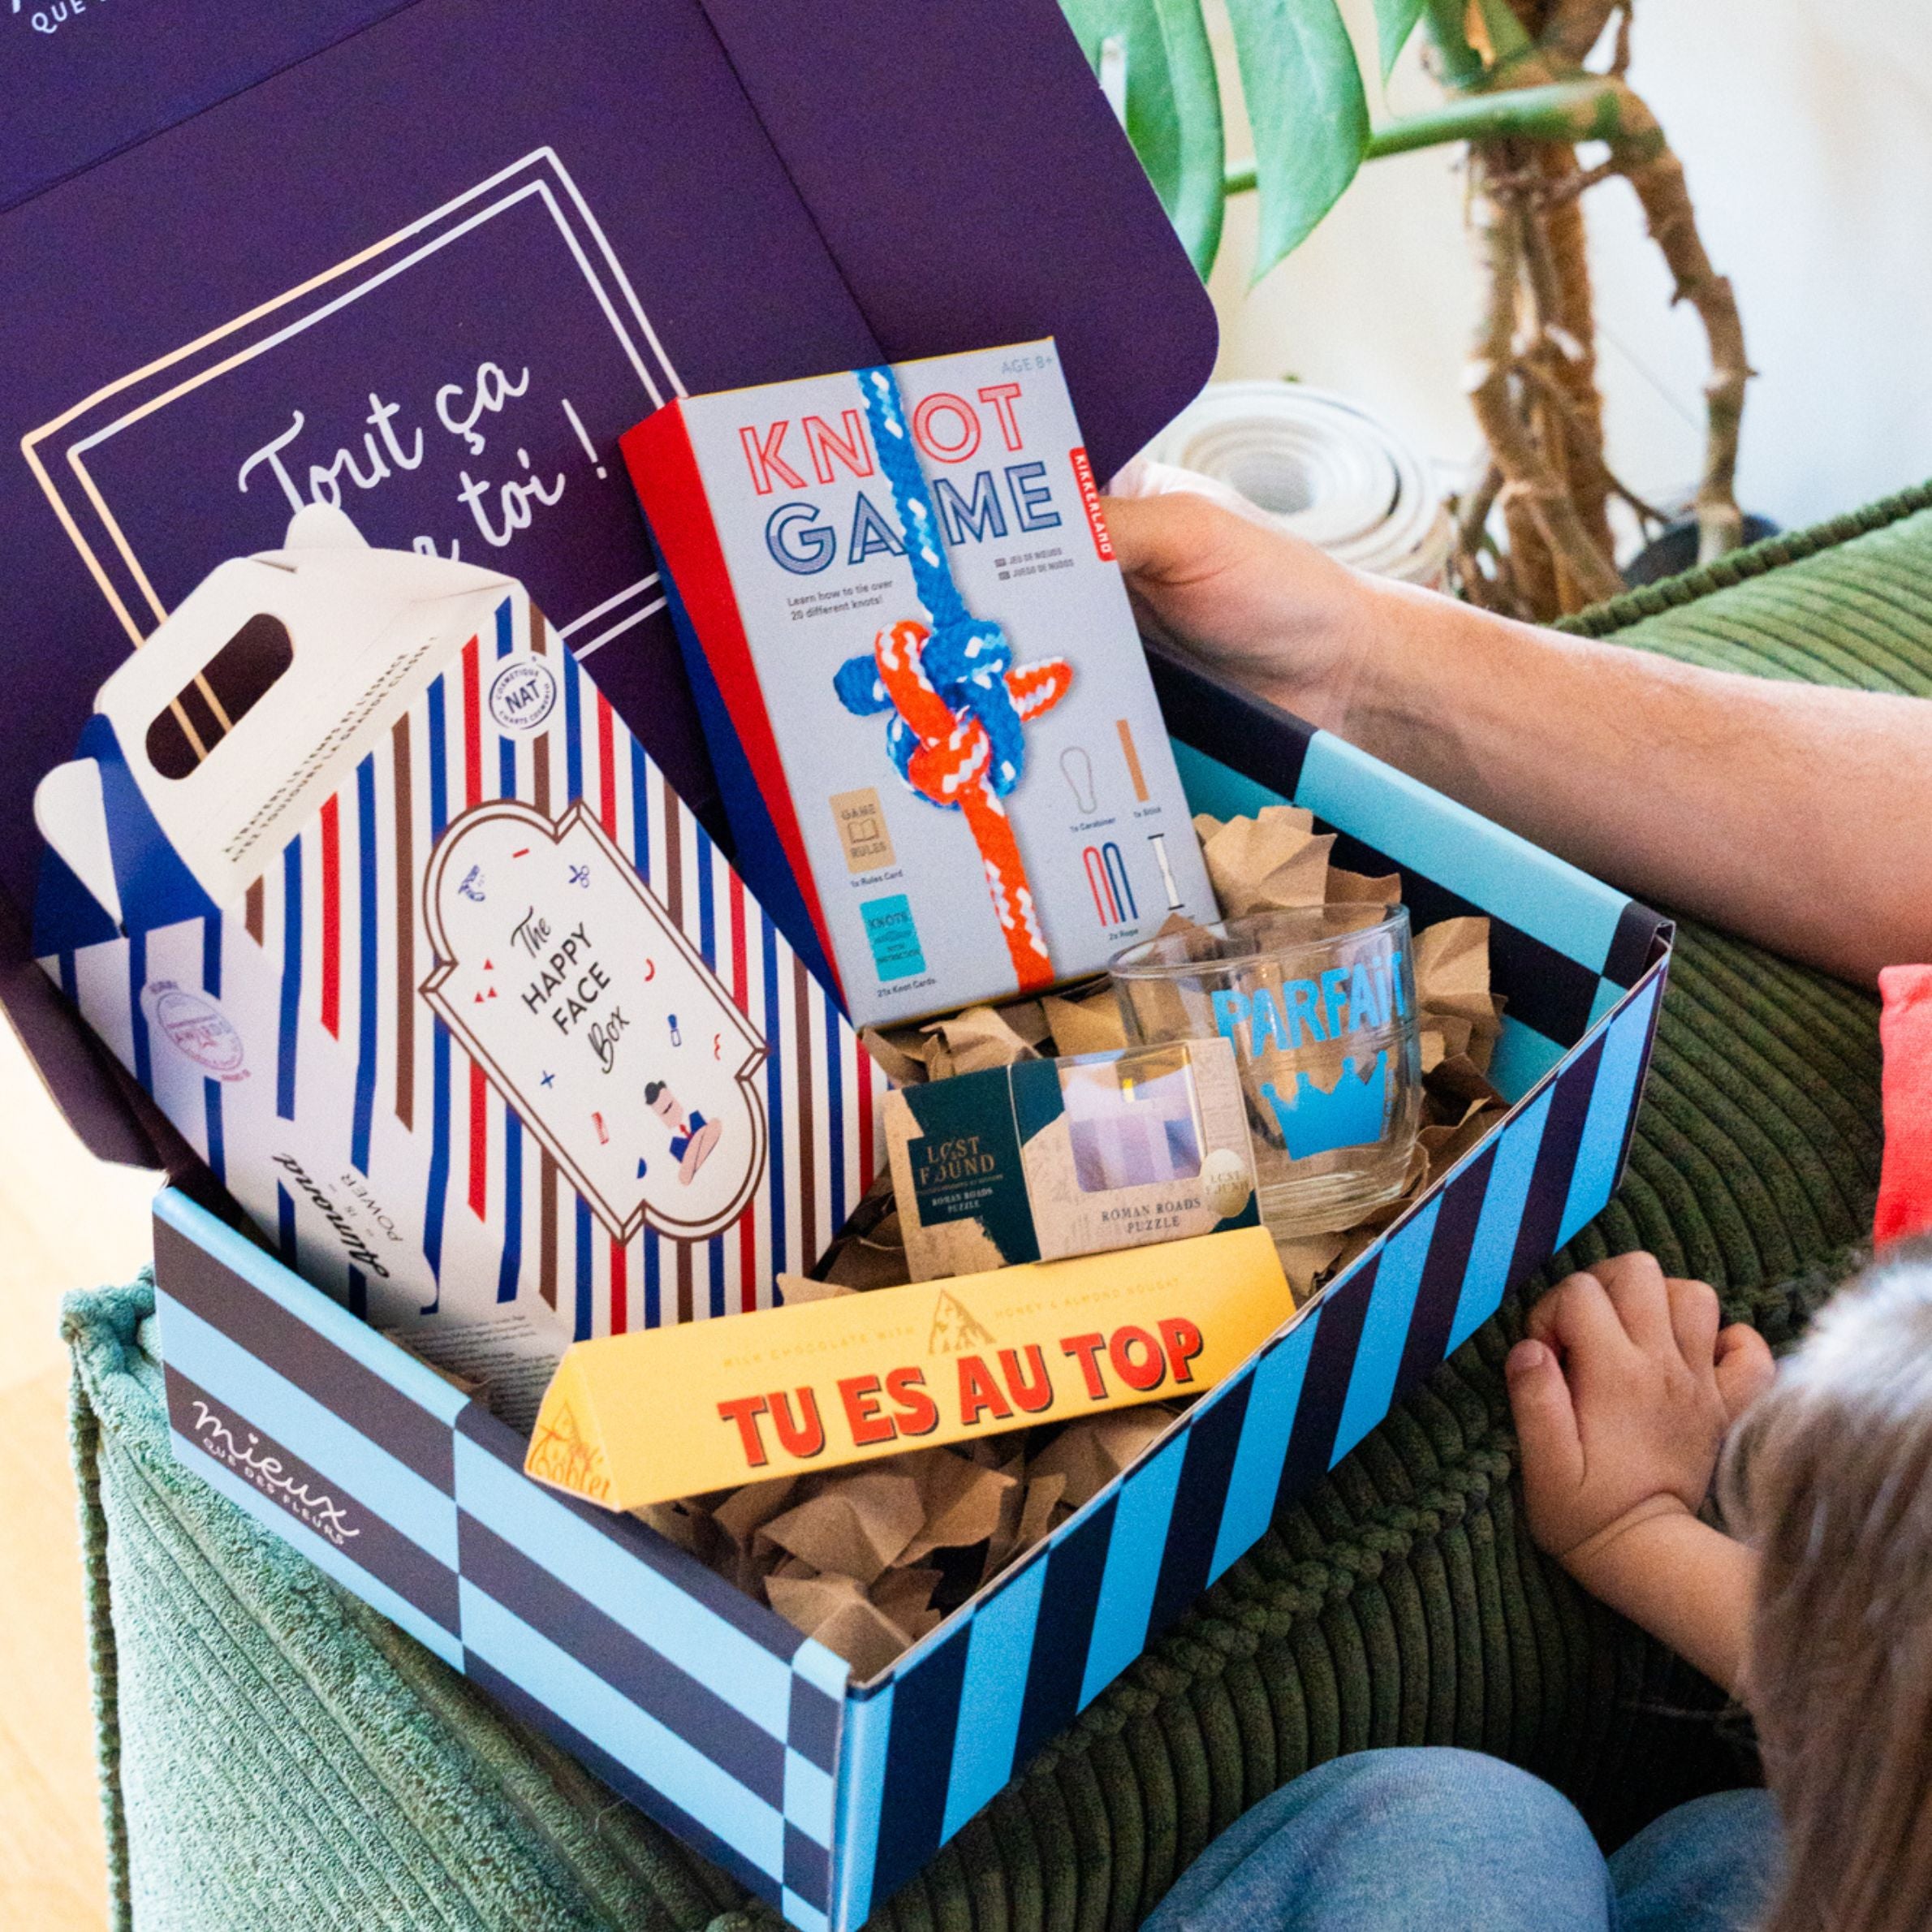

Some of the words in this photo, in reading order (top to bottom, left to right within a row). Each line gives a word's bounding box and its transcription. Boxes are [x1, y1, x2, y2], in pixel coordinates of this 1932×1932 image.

[31, 0, 86, 33] QUE
[1001, 357, 1033, 374] AGE
[1035, 356, 1054, 369] 8+
[238, 392, 423, 513] Tout
[436, 362, 528, 455] ça
[739, 382, 1024, 496] KNOT
[457, 448, 566, 547] toi
[1074, 453, 1112, 554] KIKKERLAND
[765, 460, 1063, 576] GAME
[787, 596, 817, 607] Learn
[818, 590, 841, 602] how
[843, 587, 854, 596] to
[855, 584, 869, 594] tie
[871, 580, 893, 591] over
[806, 602, 851, 618] different
[852, 594, 883, 609] knots!
[504, 679, 541, 714] NAT
[841, 803, 877, 822] GAME
[1080, 817, 1116, 831] Carabiner
[850, 840, 887, 859] RULES
[860, 874, 884, 886] Rules
[885, 869, 903, 882] Card
[510, 905, 551, 959] The
[520, 921, 593, 1016] HAPPY
[893, 984, 912, 994] Knot
[912, 977, 937, 989] Cards
[551, 961, 611, 1036] FACE
[587, 1005, 631, 1075] Box
[926, 1136, 980, 1164] LOST
[919, 1154, 996, 1185] FOUND
[340, 1173, 403, 1243] POWER
[931, 1192, 962, 1206] ROMAN
[964, 1187, 994, 1200] ROADS
[947, 1200, 981, 1214] PUZZLE
[1102, 1204, 1150, 1223] ROMAN
[1155, 1197, 1201, 1214] ROADS
[272, 1153, 390, 1279] Almond
[1127, 1216, 1180, 1234] PUZZLE
[994, 1302, 1042, 1318] HONEY
[1064, 1288, 1120, 1307] ALMOND
[1126, 1277, 1179, 1295] NOUGAT
[723, 1354, 762, 1368] MILK
[770, 1333, 868, 1360] CHOCOLATE
[877, 1326, 915, 1340] WITH
[717, 1386, 826, 1468] TU
[837, 1366, 939, 1447] ES
[957, 1344, 1054, 1425] AU
[1059, 1317, 1205, 1400] TOP
[192, 1400, 360, 1537] mieux
[203, 1438, 236, 1467] QUE
[282, 1494, 345, 1546] FLEURS
